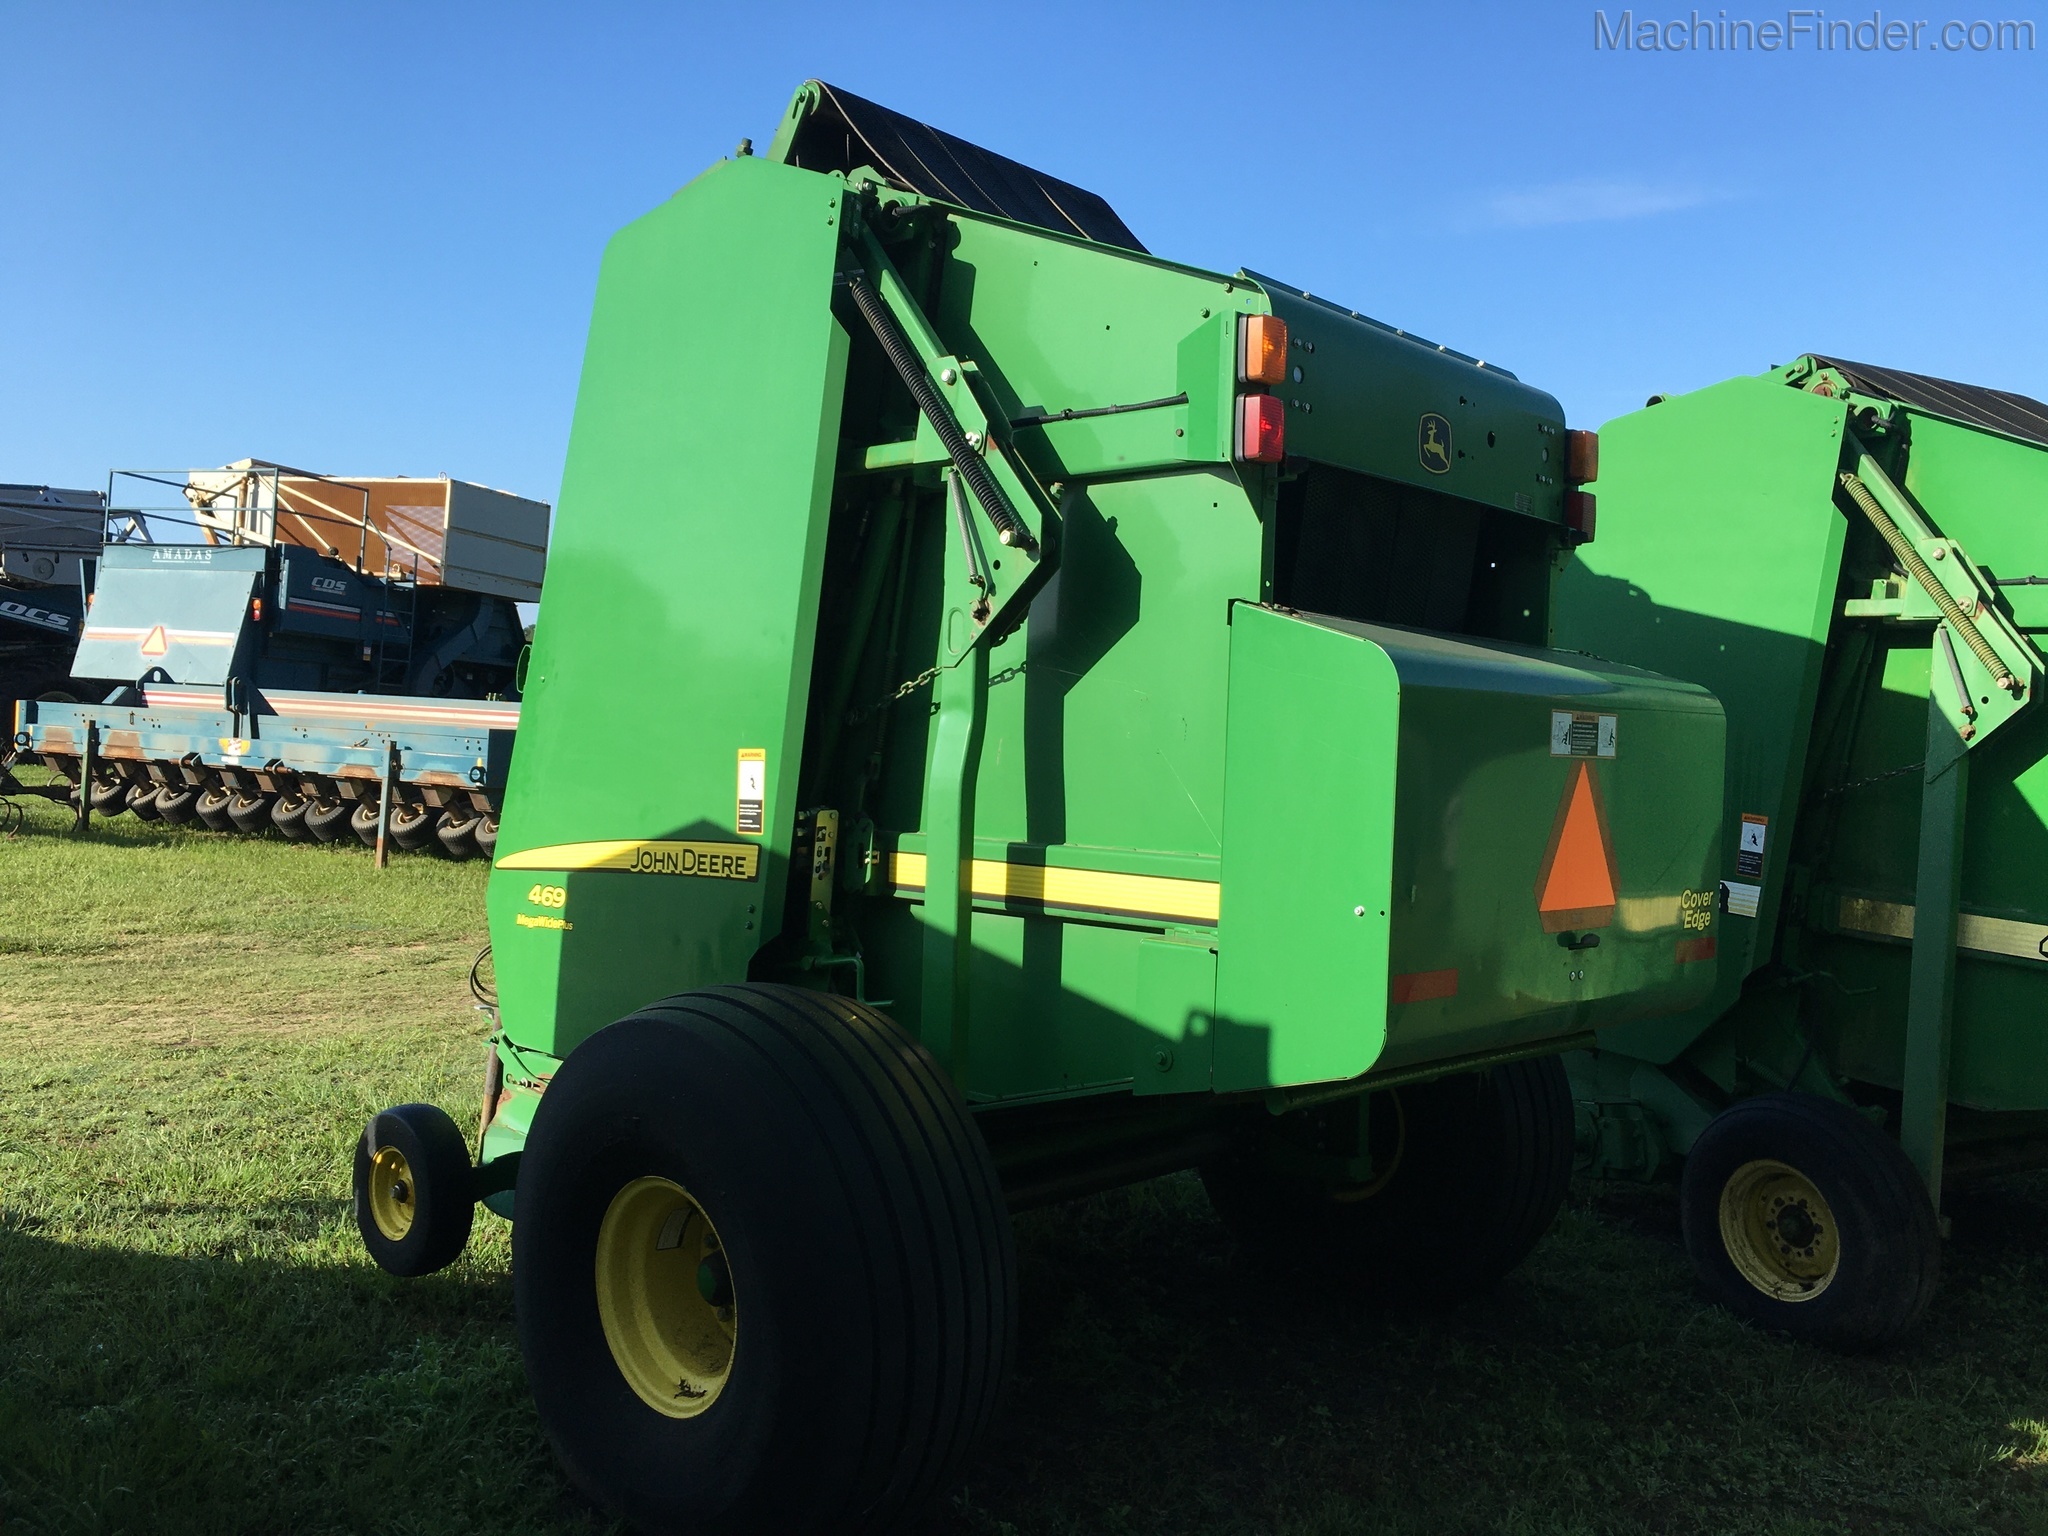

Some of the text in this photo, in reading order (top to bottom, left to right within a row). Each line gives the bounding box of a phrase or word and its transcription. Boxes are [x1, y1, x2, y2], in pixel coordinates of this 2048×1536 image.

[152, 548, 212, 560] AMADAS
[311, 576, 347, 591] CDS
[630, 846, 747, 876] JOHN DEERE
[528, 884, 566, 909] 469
[1681, 889, 1714, 909] Cover
[1683, 909, 1711, 931] Edge
